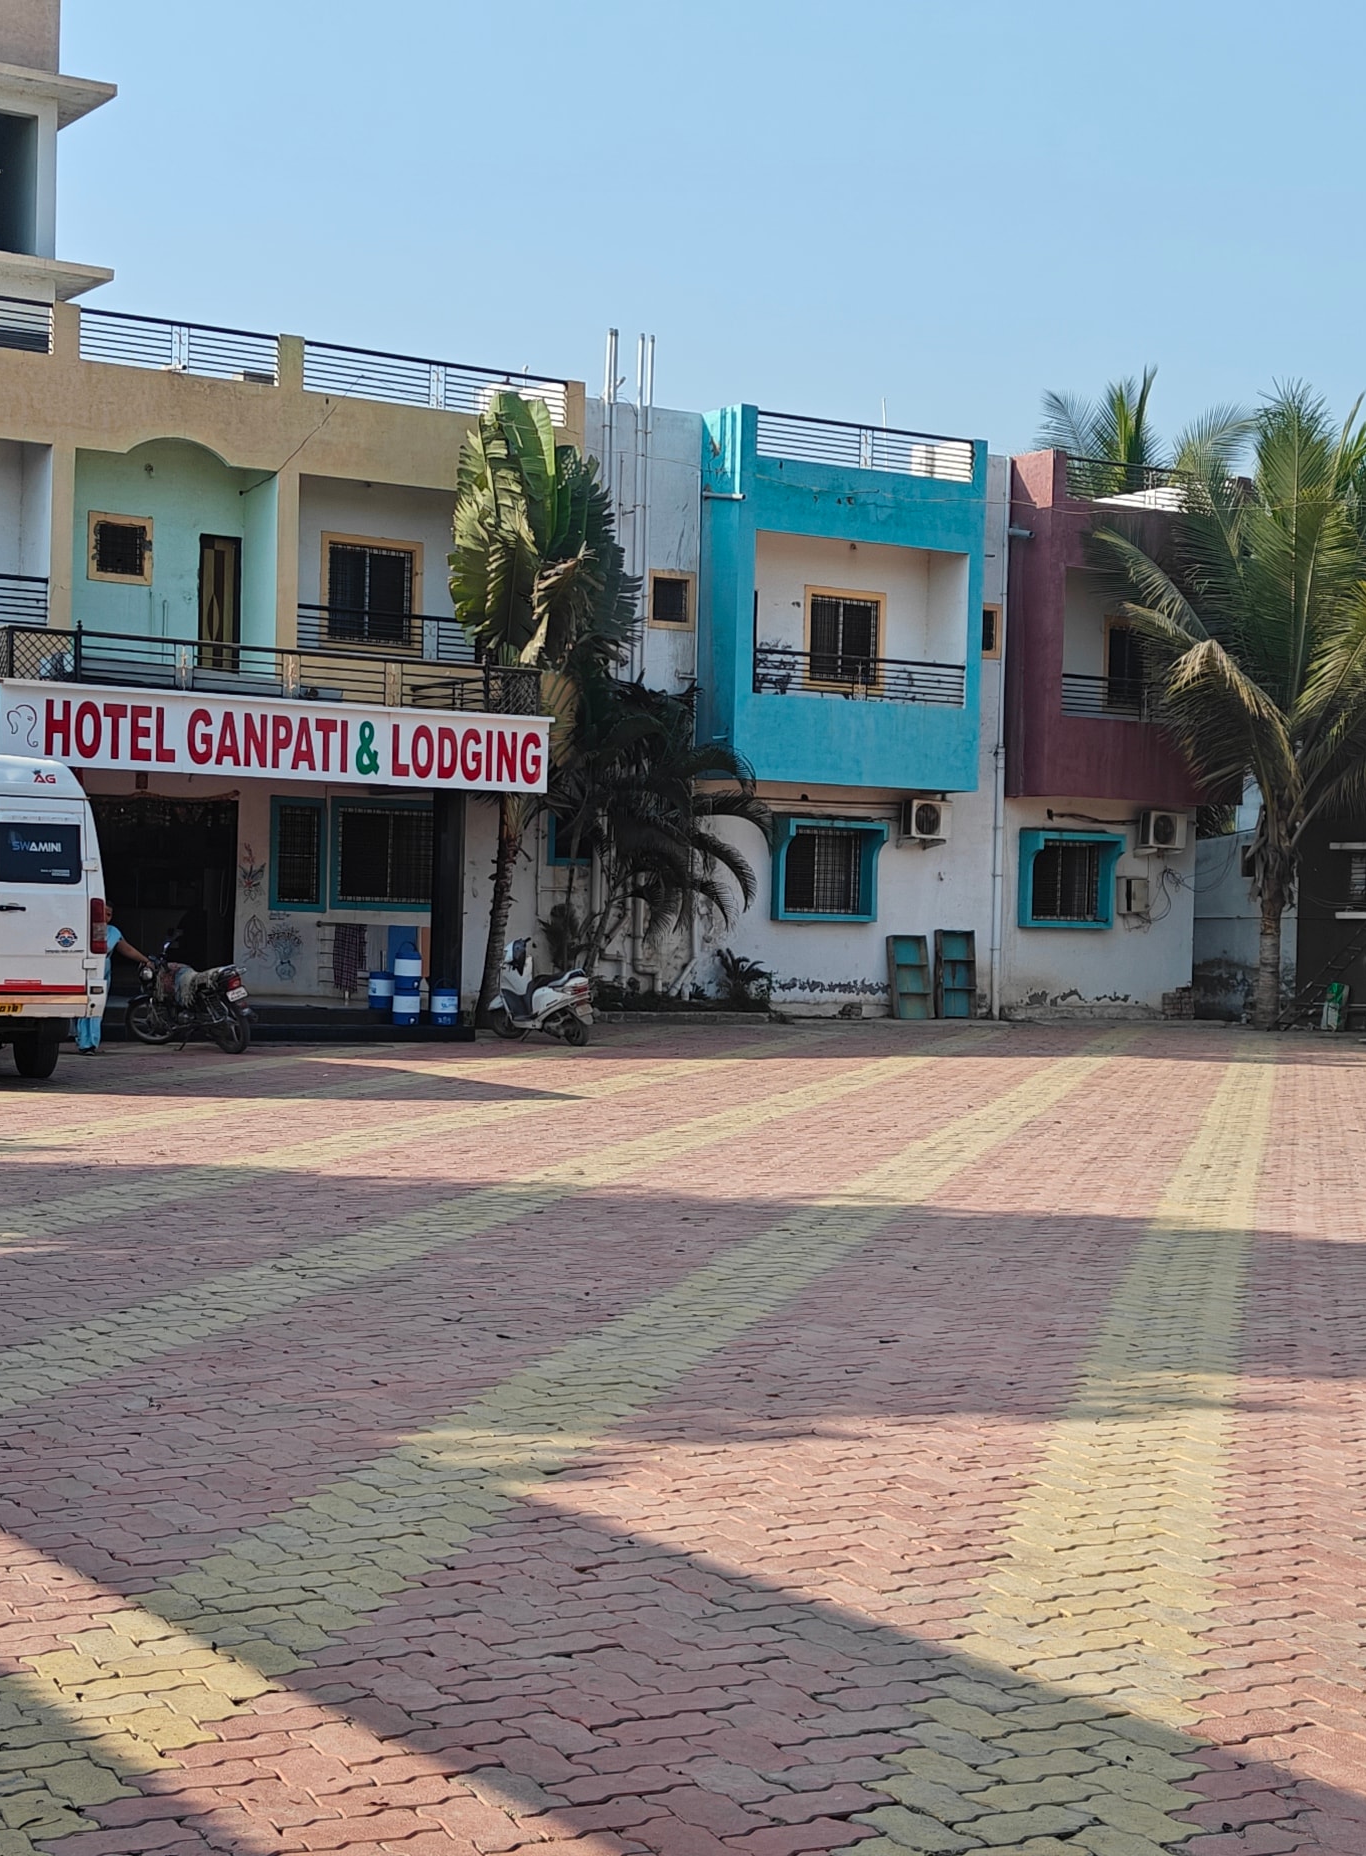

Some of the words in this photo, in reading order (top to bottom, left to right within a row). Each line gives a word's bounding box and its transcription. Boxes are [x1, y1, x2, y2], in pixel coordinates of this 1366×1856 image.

[44, 699, 176, 763] HOTEL
[187, 708, 349, 773] GANPATI
[355, 721, 380, 775] &
[392, 723, 542, 785] LODGING
[34, 773, 57, 784] AG
[11, 841, 62, 852] SWAMINI
